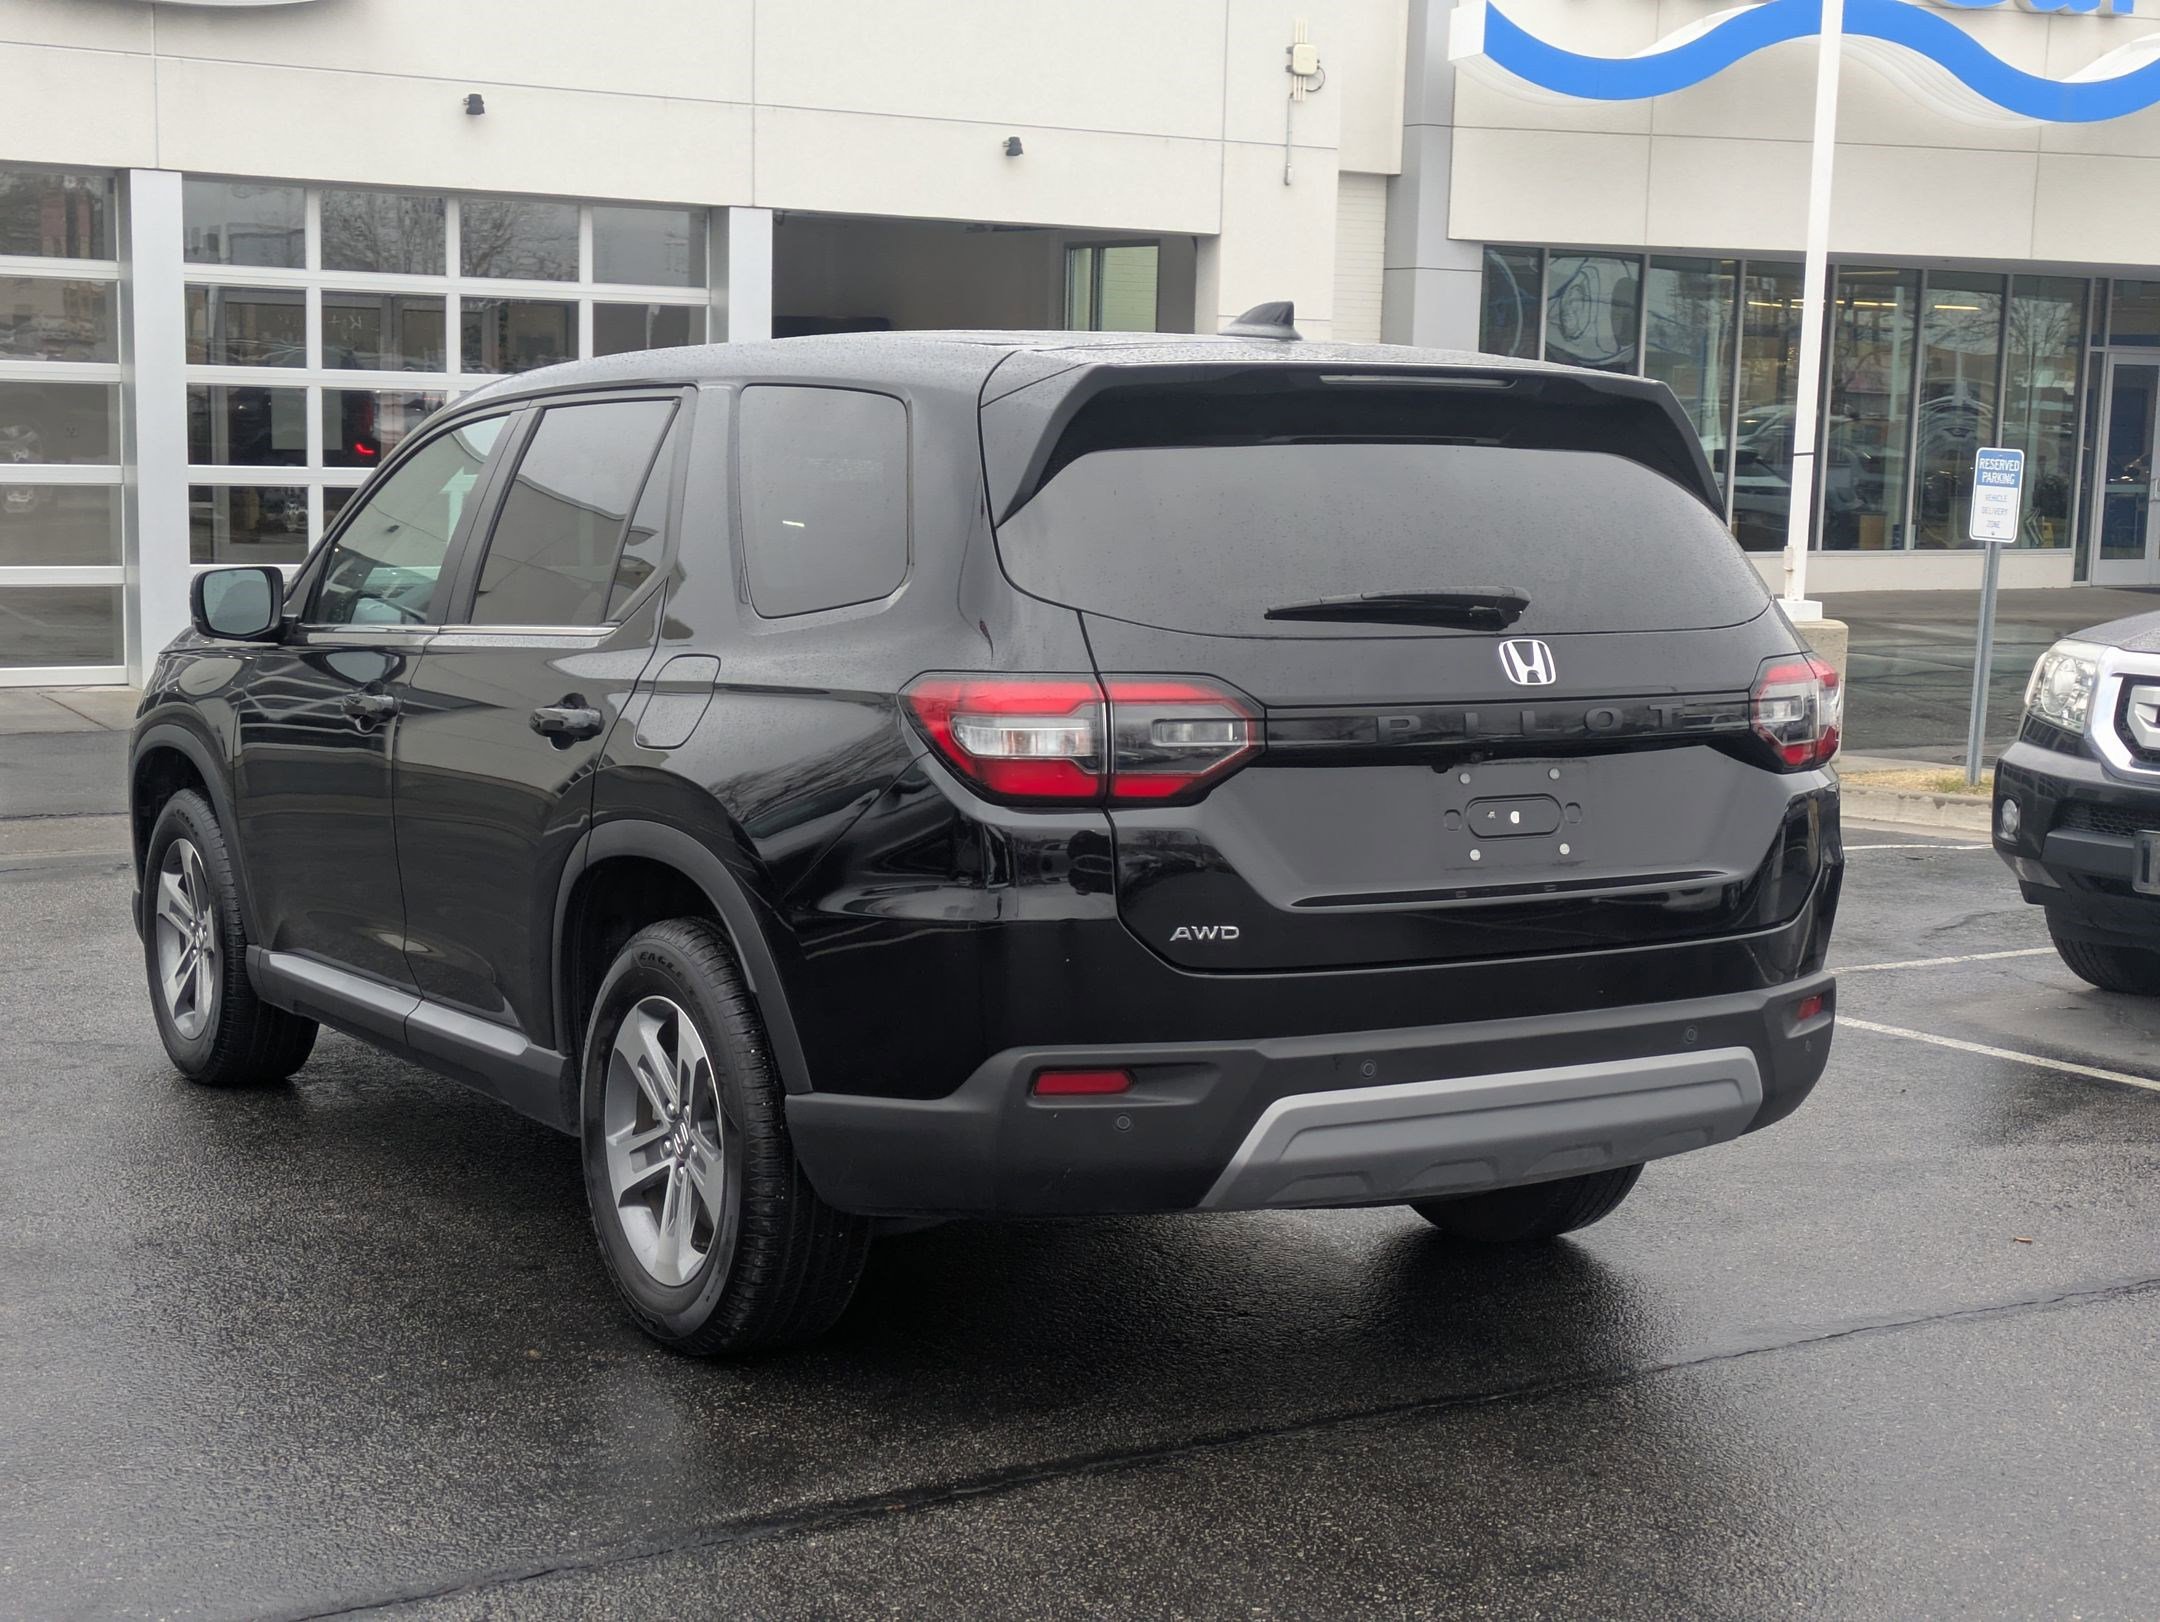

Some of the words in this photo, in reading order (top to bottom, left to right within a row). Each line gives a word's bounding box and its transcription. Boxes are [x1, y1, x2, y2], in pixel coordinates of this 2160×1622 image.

[1979, 458, 2020, 471] RESERVED
[1982, 472, 2015, 484] PARKING
[1376, 703, 1683, 744] PILOT
[1169, 925, 1240, 942] AWD
